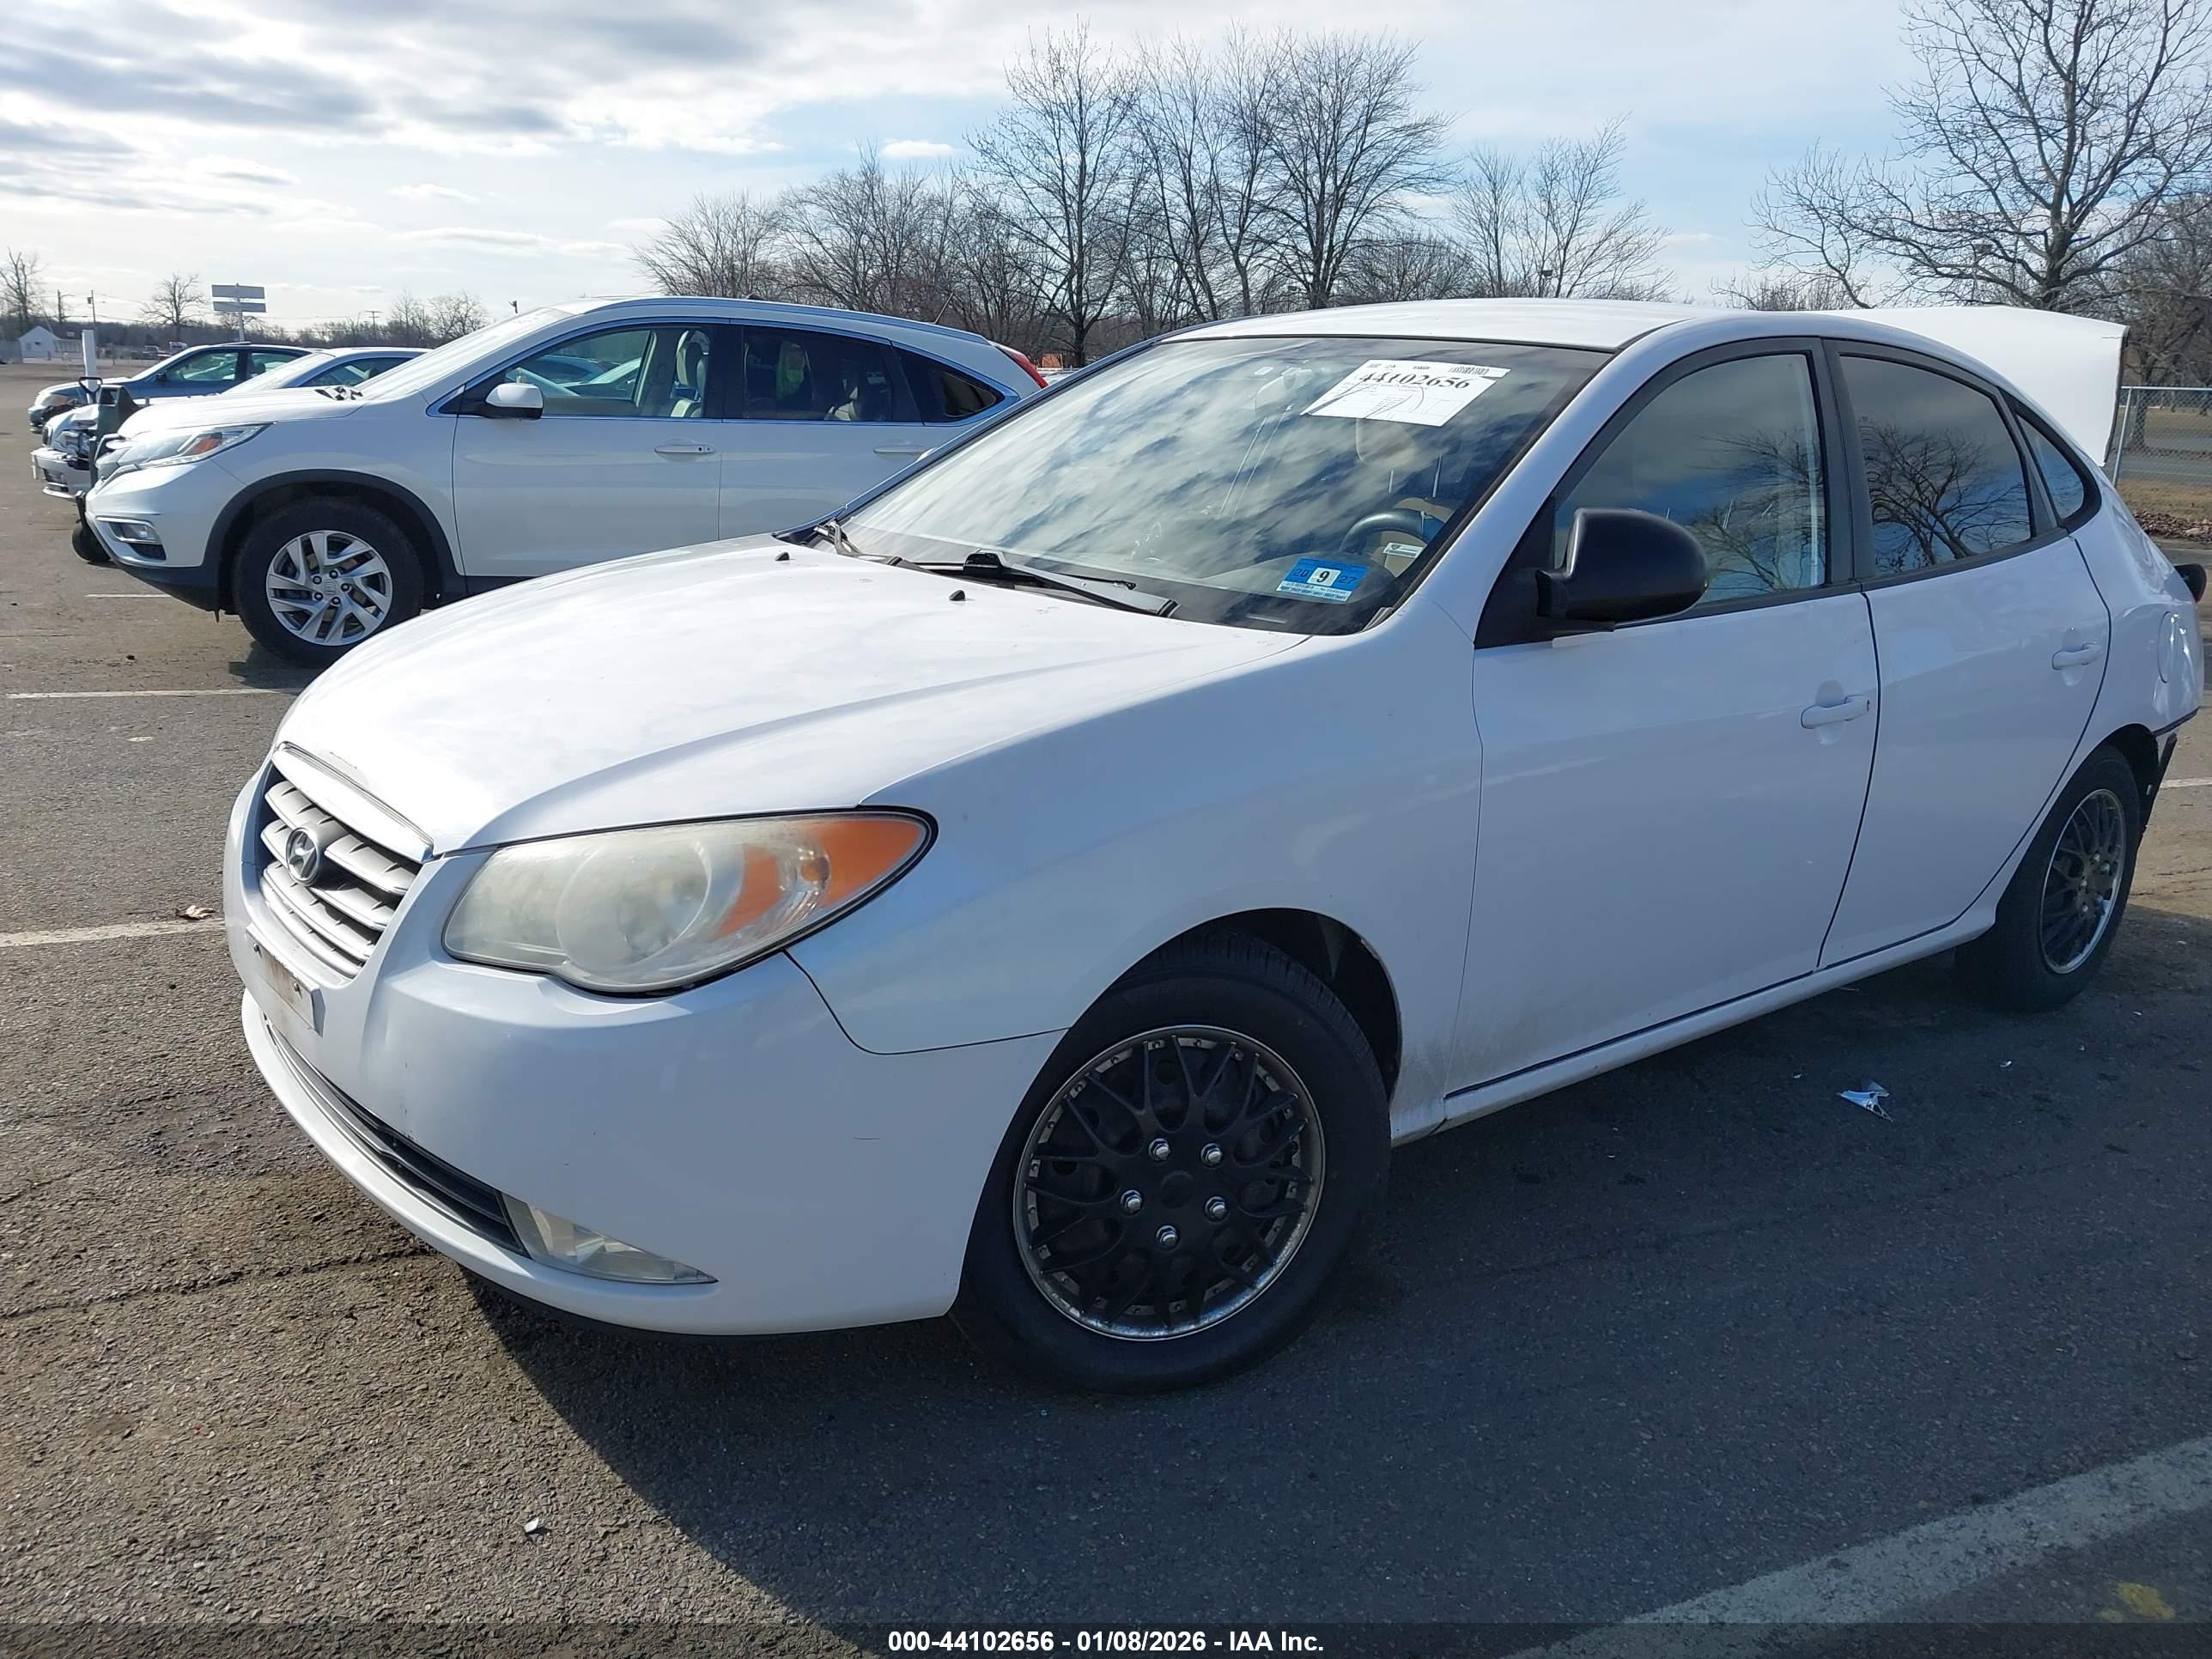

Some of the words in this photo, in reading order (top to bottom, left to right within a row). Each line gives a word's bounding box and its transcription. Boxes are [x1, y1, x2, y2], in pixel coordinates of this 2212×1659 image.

[1358, 371, 1471, 389] 44102656
[1292, 568, 1310, 578] 20
[1316, 570, 1330, 583] 9
